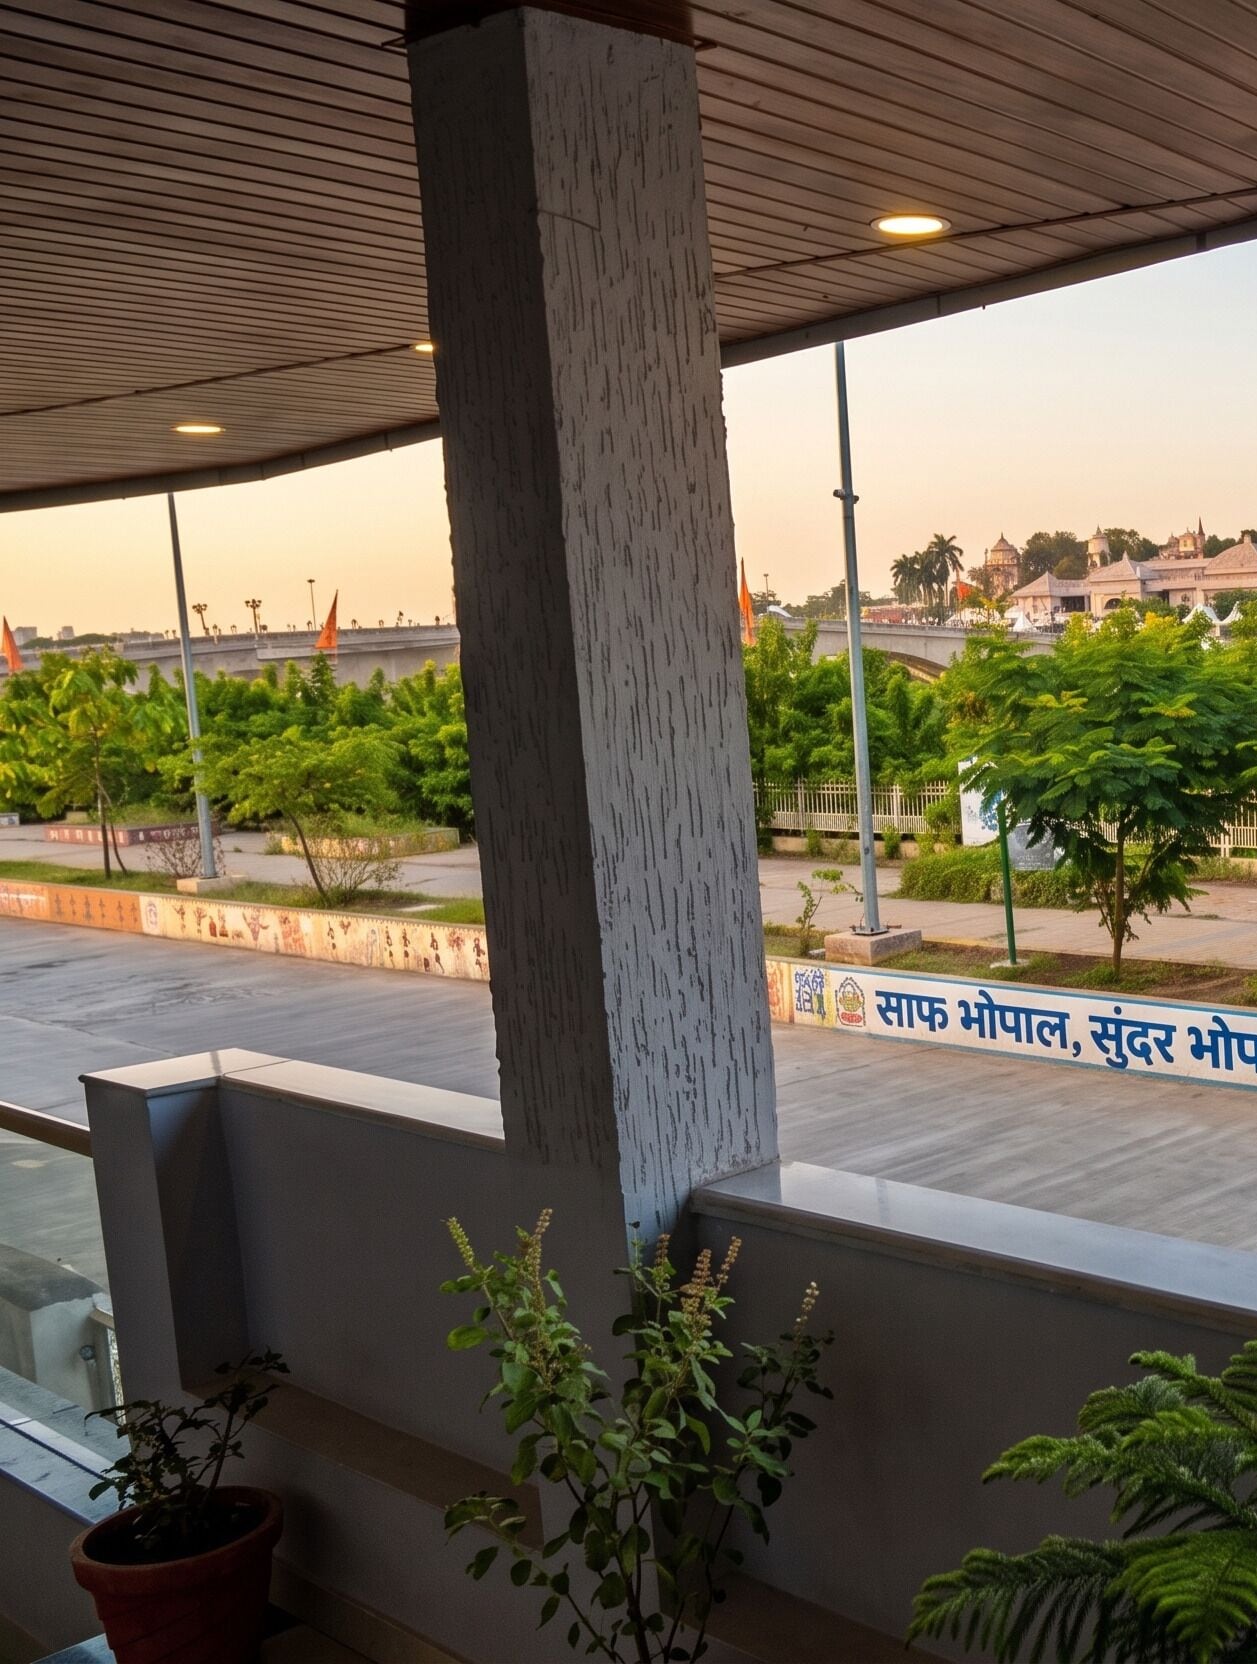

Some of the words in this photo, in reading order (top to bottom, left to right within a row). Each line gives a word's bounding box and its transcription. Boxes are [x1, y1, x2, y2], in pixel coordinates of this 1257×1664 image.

[875, 990, 949, 1032] साफ
[958, 989, 1082, 1057] भोपाल,
[1088, 1005, 1177, 1070] सुंदर
